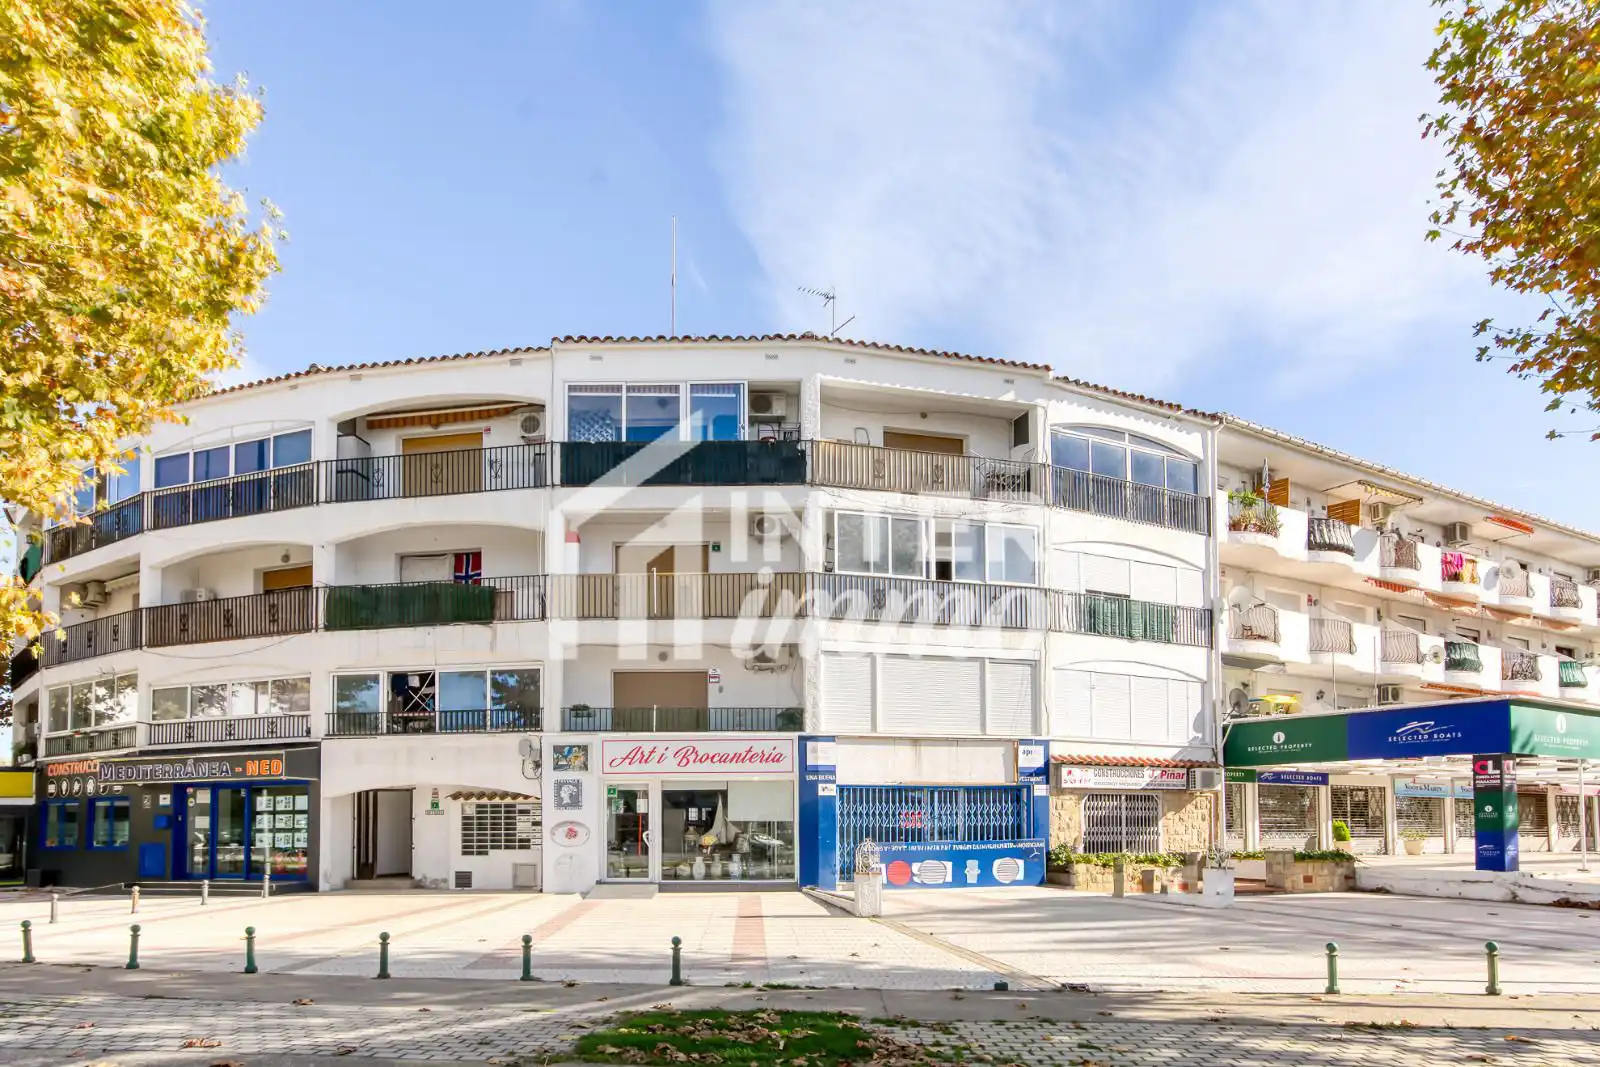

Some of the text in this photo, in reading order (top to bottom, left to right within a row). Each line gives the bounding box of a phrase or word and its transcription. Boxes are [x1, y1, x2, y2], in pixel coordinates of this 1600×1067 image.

[1388, 734, 1429, 743] SELECTED
[609, 746, 657, 768] Art
[673, 745, 787, 768] Brocanteria
[99, 758, 232, 782] MEDITERRÁNEA
[1094, 768, 1144, 779] CONSTRUCCIONES
[1475, 760, 1500, 775] CL
